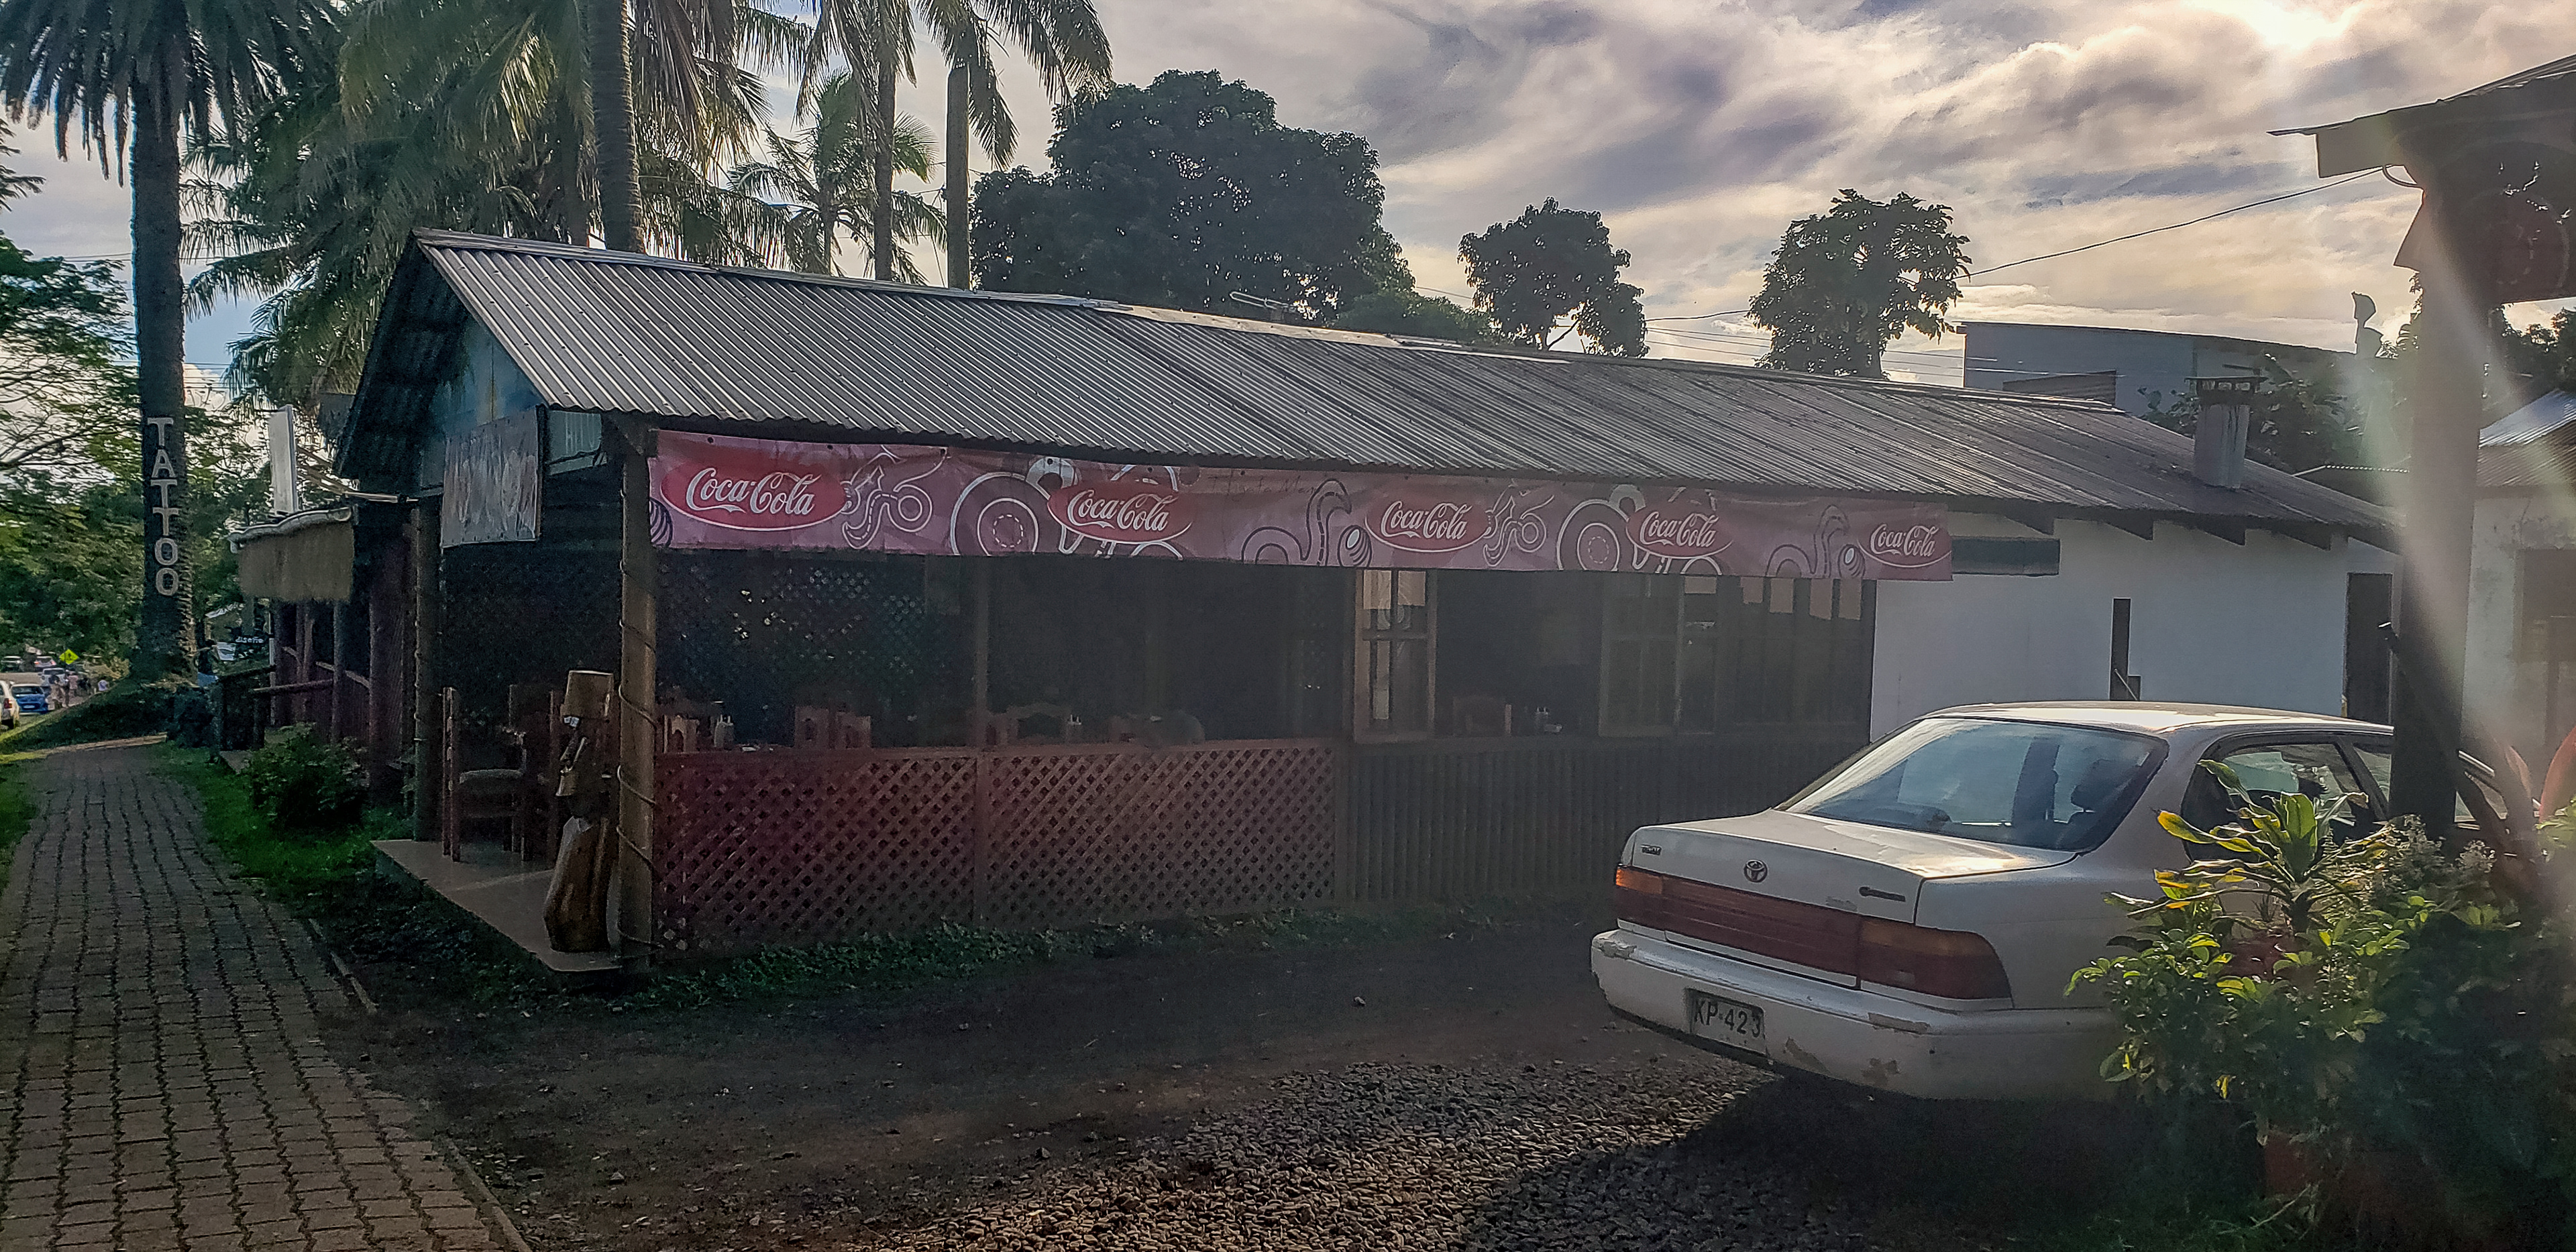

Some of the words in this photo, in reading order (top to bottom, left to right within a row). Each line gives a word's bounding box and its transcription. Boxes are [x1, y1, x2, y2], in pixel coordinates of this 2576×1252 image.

[147, 417, 180, 596] TATTOO
[686, 467, 822, 515] Coca-Cola
[1067, 490, 1179, 532] Coca-Cola
[1381, 500, 1473, 540] Coca-Cola
[1640, 511, 1719, 547] Coca-Cola
[1870, 523, 1939, 557] Coca-Cola
